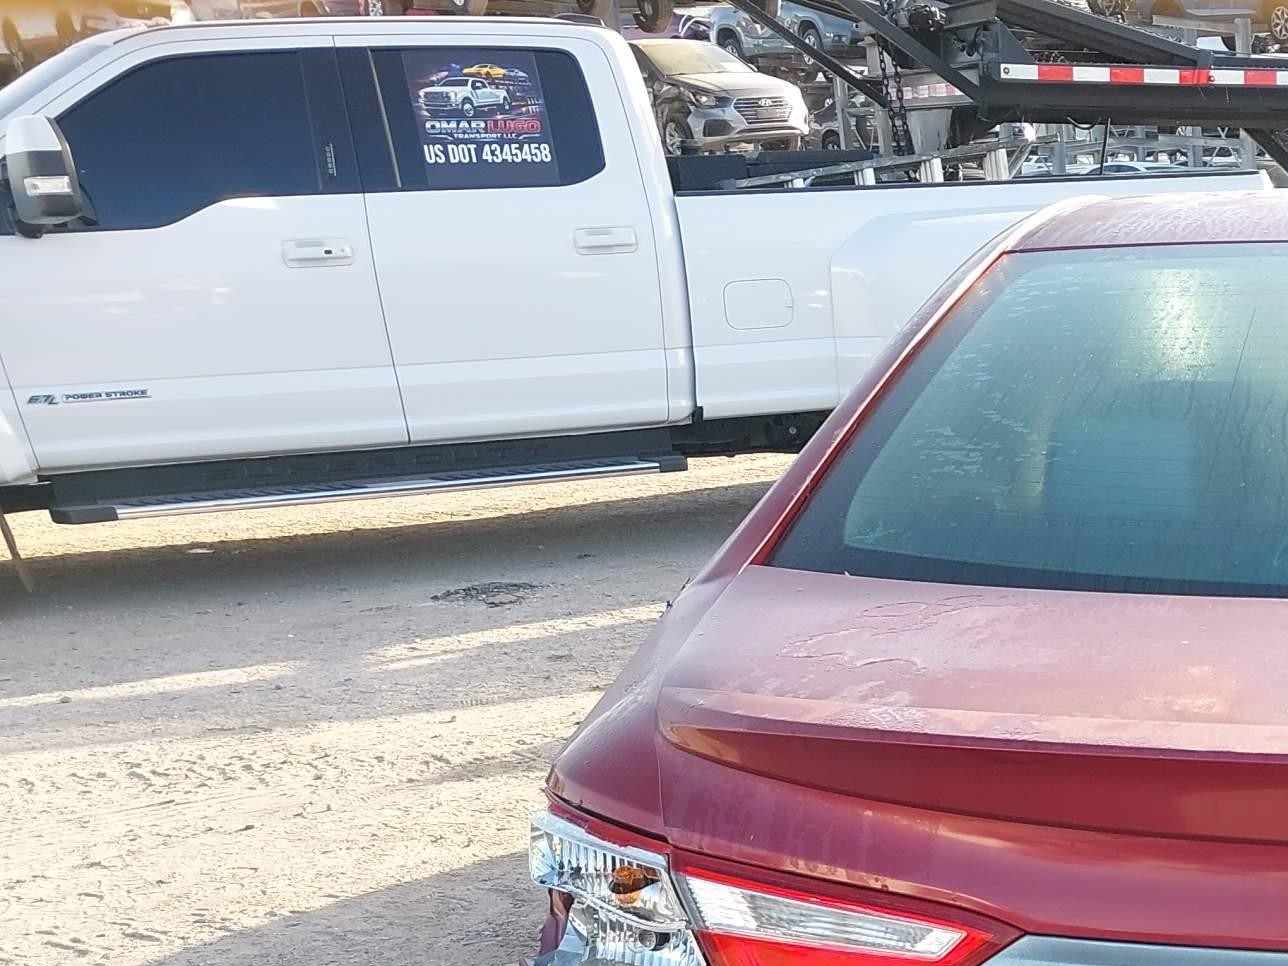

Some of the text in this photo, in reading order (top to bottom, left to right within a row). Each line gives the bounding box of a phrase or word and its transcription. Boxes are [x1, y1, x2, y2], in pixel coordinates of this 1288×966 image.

[425, 119, 541, 134] OMAR LUGO
[424, 143, 552, 164] US DOT 4345458
[64, 389, 150, 401] POWER STROKE
